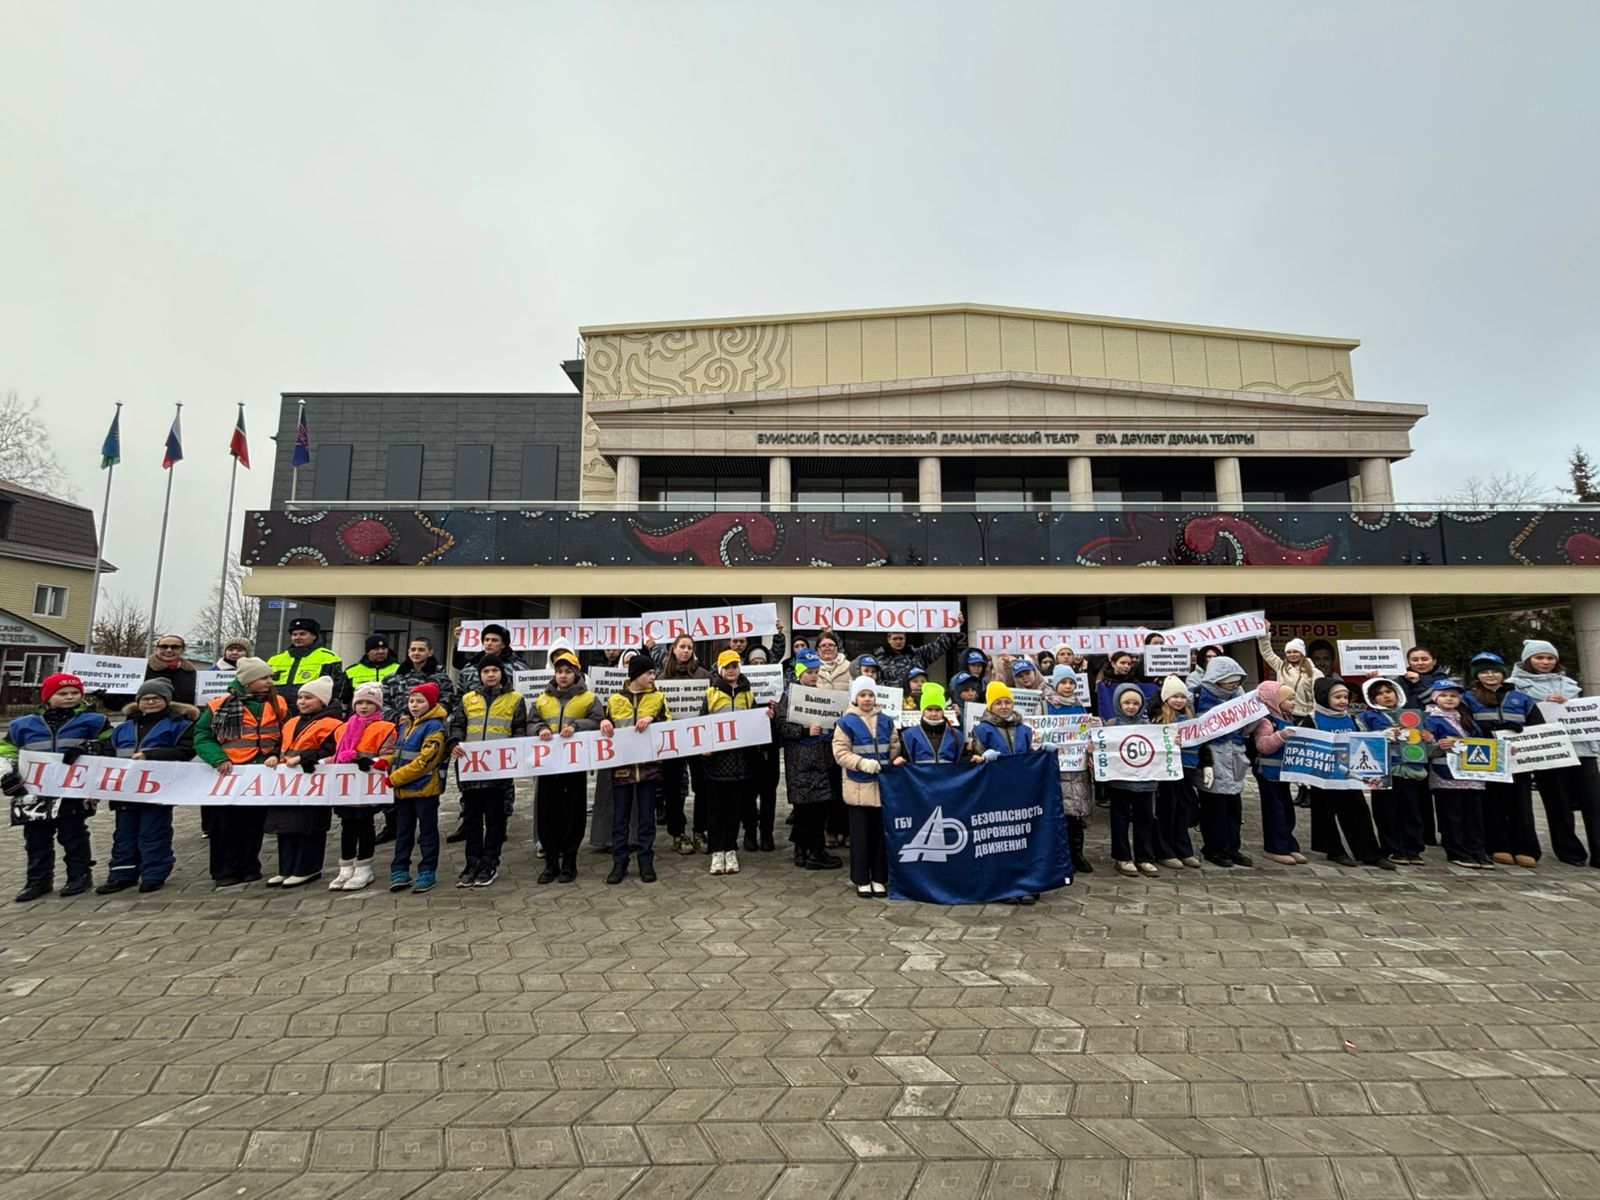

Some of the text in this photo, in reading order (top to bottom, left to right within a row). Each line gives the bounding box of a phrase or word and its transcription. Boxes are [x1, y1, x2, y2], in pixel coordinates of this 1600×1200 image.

[757, 432, 1080, 446] БУИНСКИЙ ГОСУДАРСТВЕННЫЙ ДРАМАТИЧЕСКИЙ ТЕАТР
[1167, 433, 1209, 446] ДРАМА
[1209, 433, 1256, 445] ТЕАТРЫ
[793, 605, 958, 629] СКОРОСТЬ
[644, 614, 754, 641] СБАВЬ
[462, 625, 641, 649] ВДИТЕЛЬ
[96, 661, 122, 669] Сбавь
[72, 670, 113, 679] скорость
[804, 694, 831, 705] Выпил
[804, 706, 844, 718] заводись!
[1565, 703, 1599, 713] Устал?
[461, 719, 739, 773] ЖЕРТВ ДТП
[1126, 740, 1147, 760] 60
[1285, 746, 1335, 762] ПРАВИЛА
[1517, 742, 1562, 753] езопасности
[1284, 756, 1335, 773] ЖИЗНИ!
[22, 760, 389, 797] ДЕНЬ ПАМЯТИ
[894, 816, 913, 830] ГБУ
[970, 804, 1044, 827] БЕЗОПАСНОСТЬ
[972, 822, 1033, 844] ДОРОЖНОГО
[974, 837, 1028, 860] ДВИЖЕНИЯ
